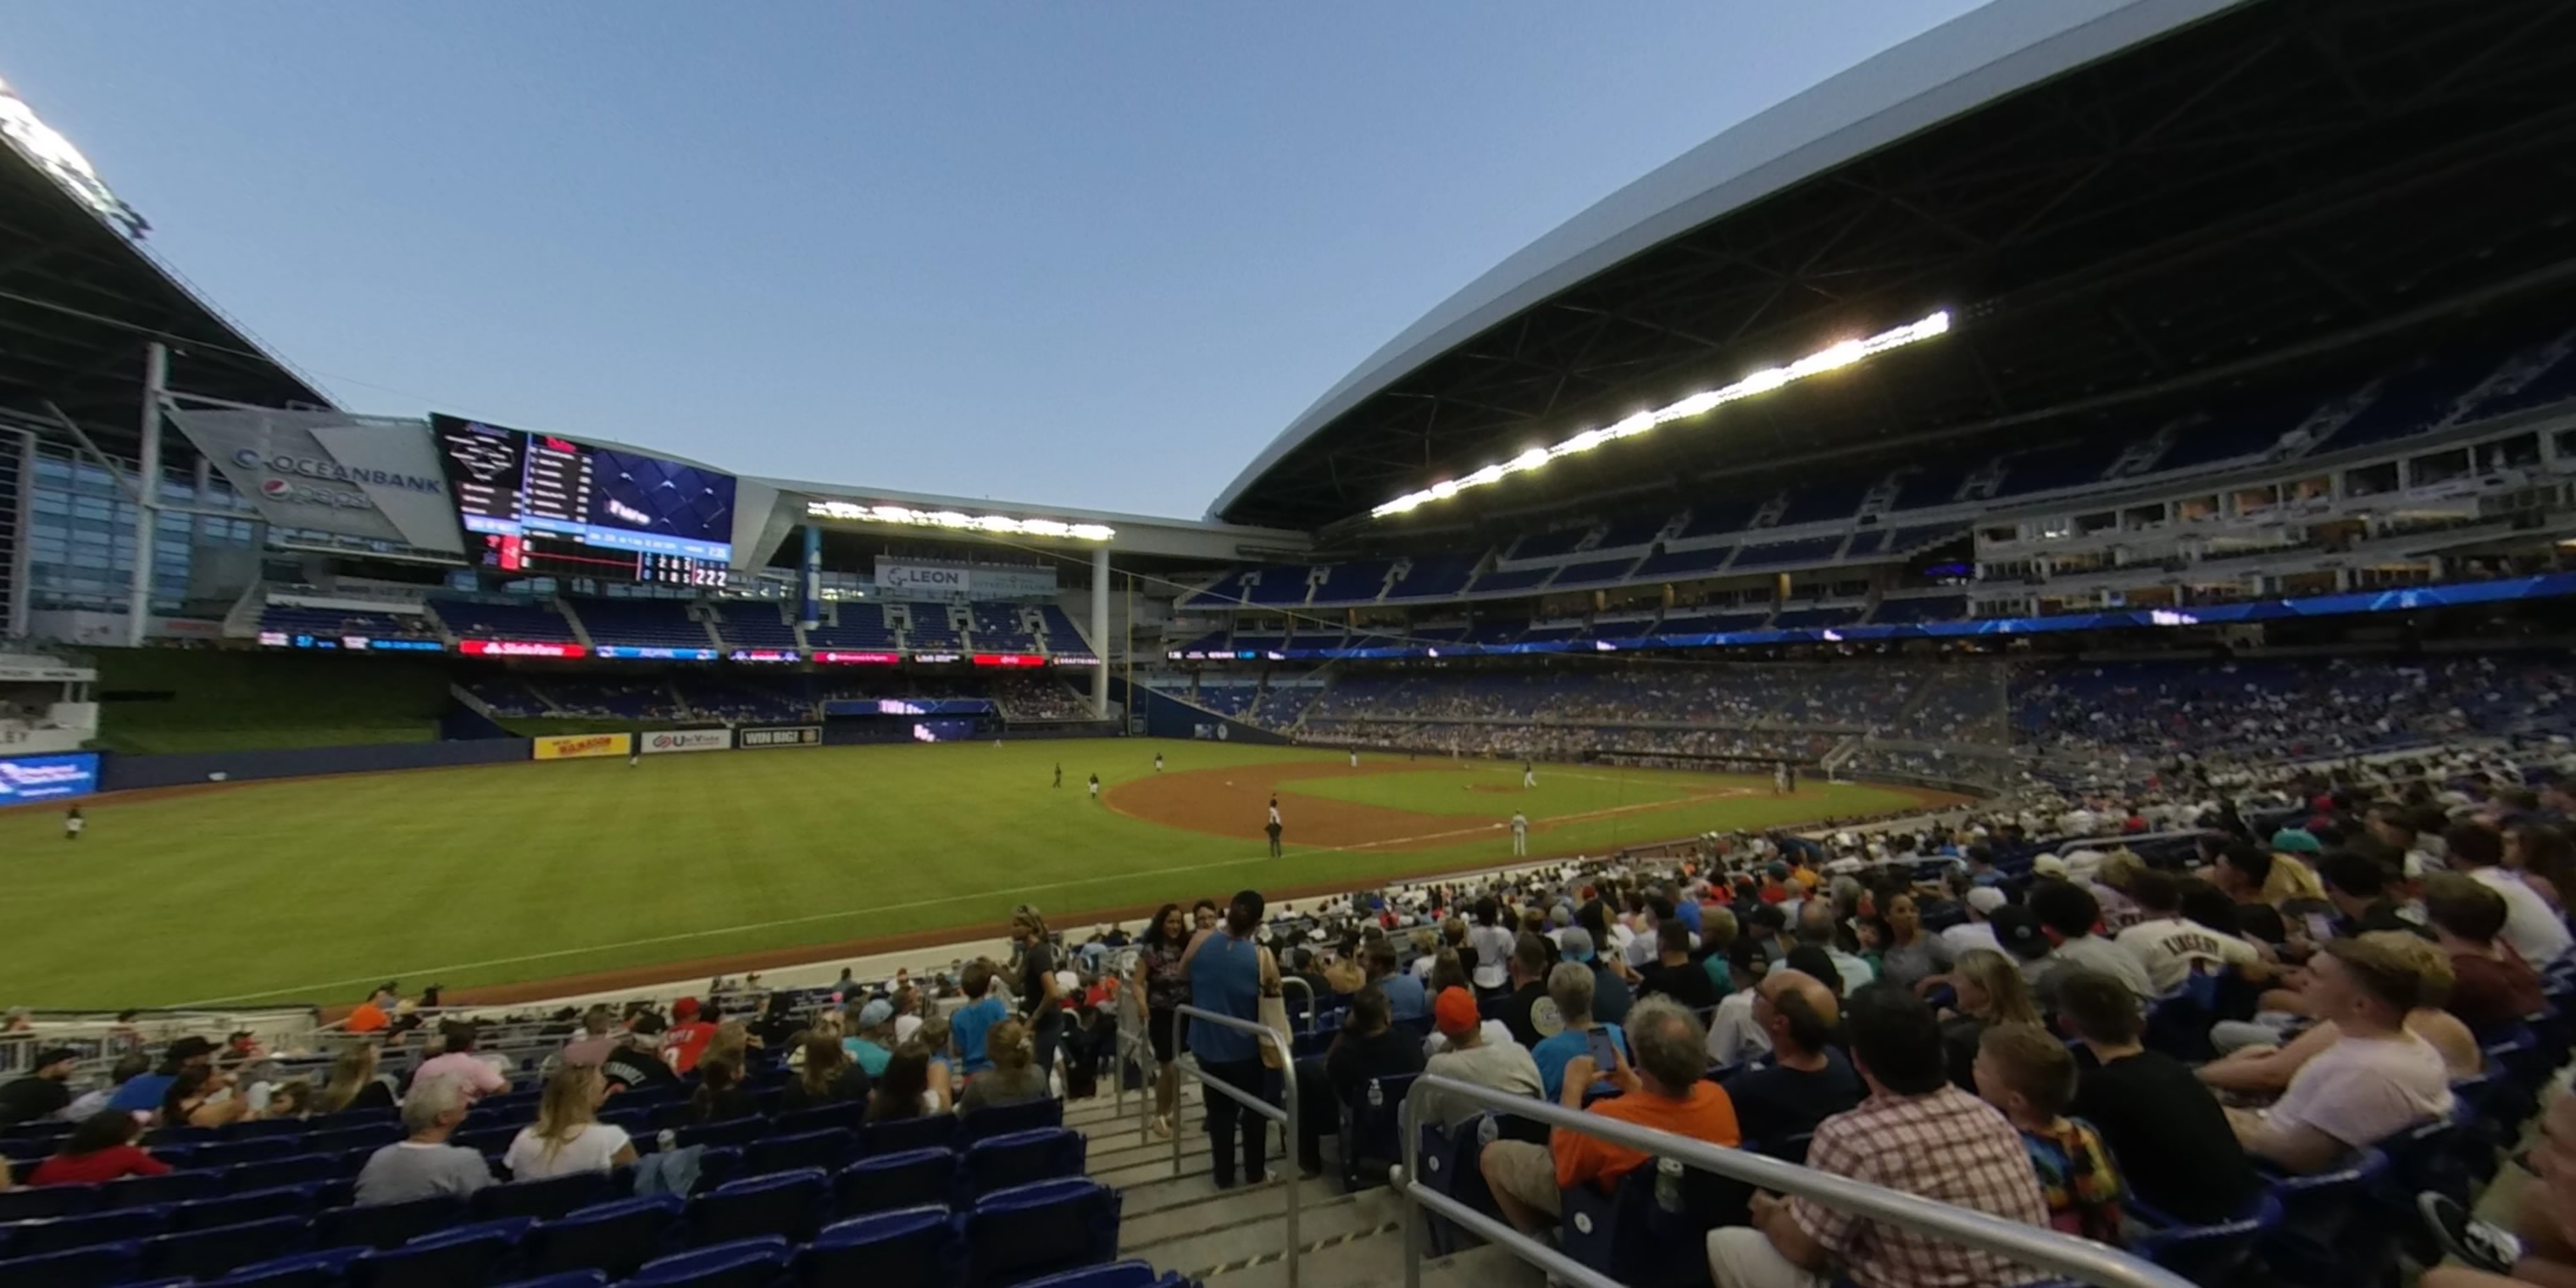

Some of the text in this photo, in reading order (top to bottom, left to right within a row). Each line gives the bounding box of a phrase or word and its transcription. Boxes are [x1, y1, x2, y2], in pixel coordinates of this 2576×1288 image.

[272, 455, 441, 494] OCEANBANK
[910, 570, 959, 584] LEON
[746, 730, 799, 745] WIN BIG!
